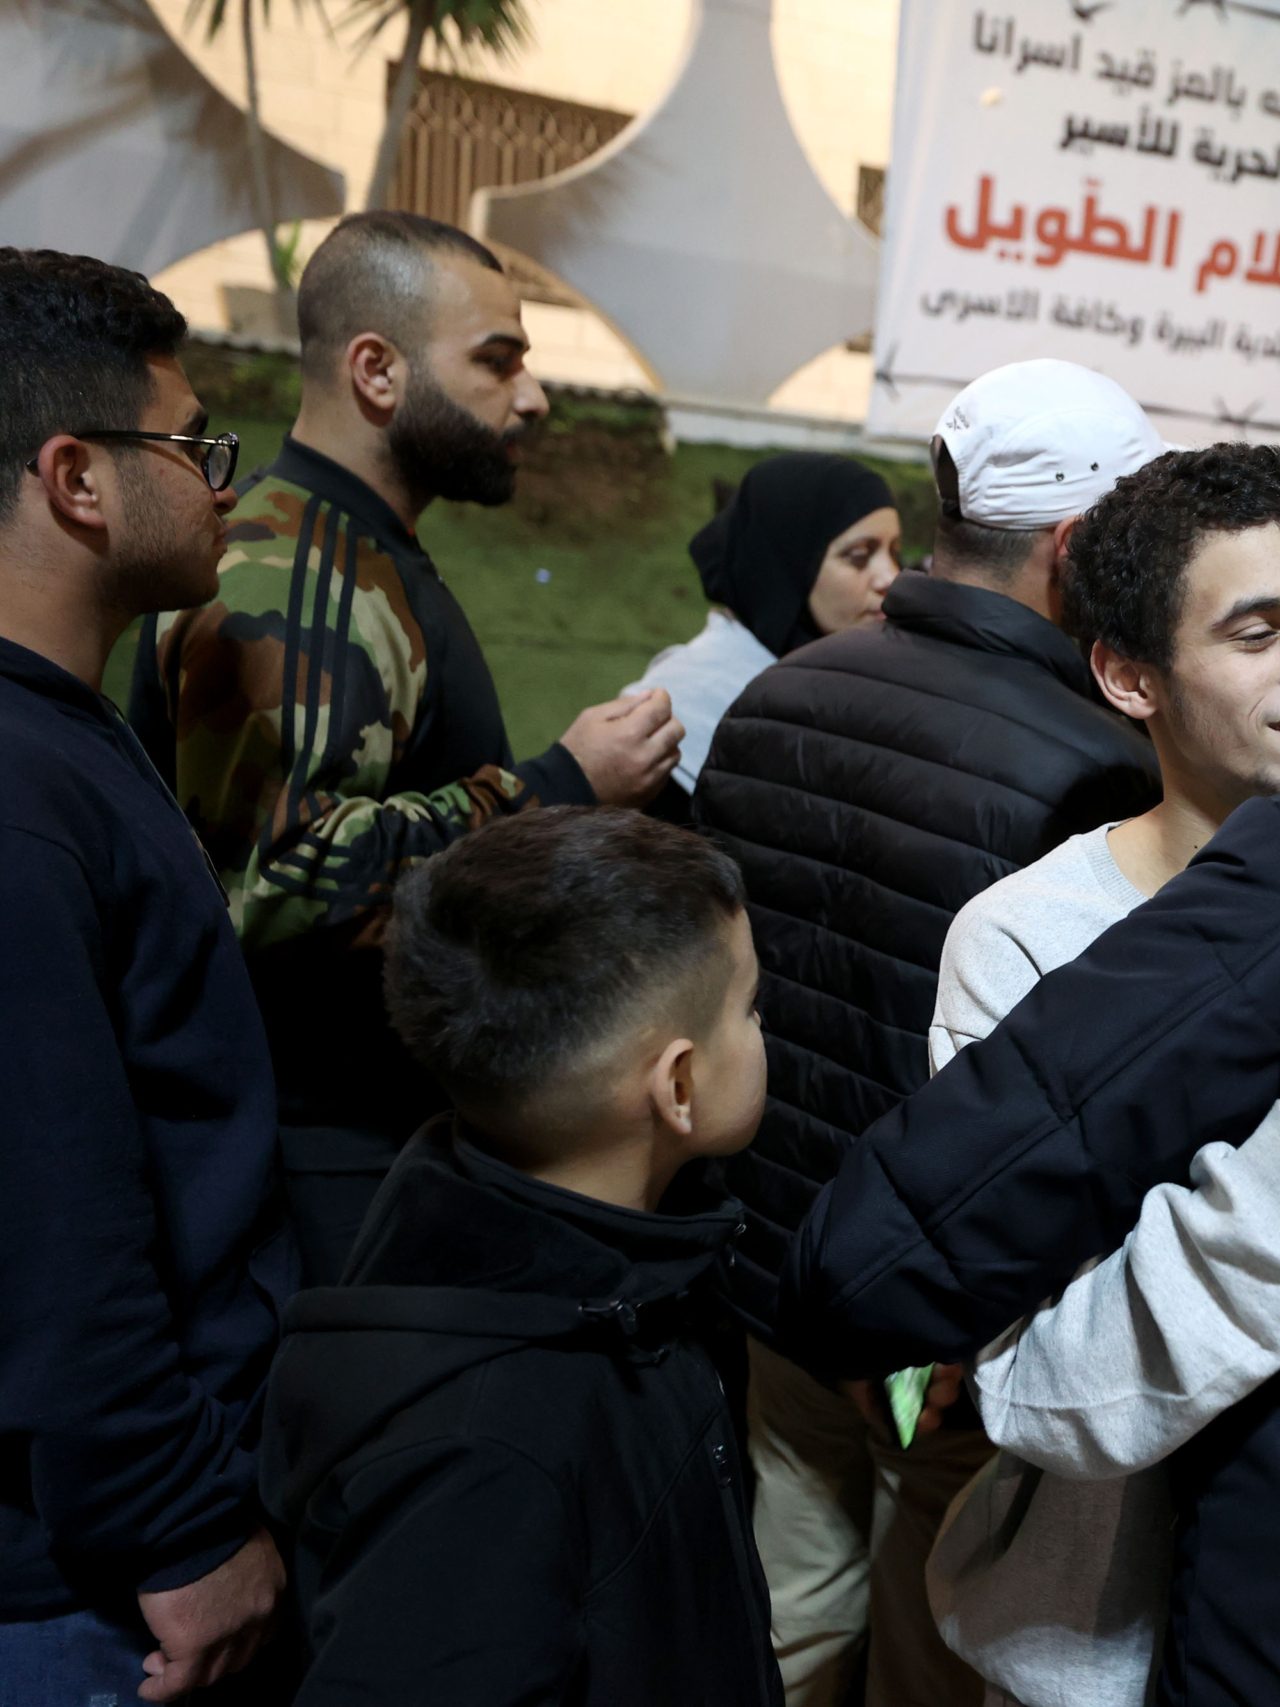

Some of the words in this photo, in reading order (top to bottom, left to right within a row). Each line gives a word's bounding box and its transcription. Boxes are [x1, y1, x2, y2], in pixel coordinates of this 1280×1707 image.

[1095, 46, 1157, 96] قيد
[1049, 291, 1146, 350] وكافة
[1152, 309, 1228, 358] البيرة
